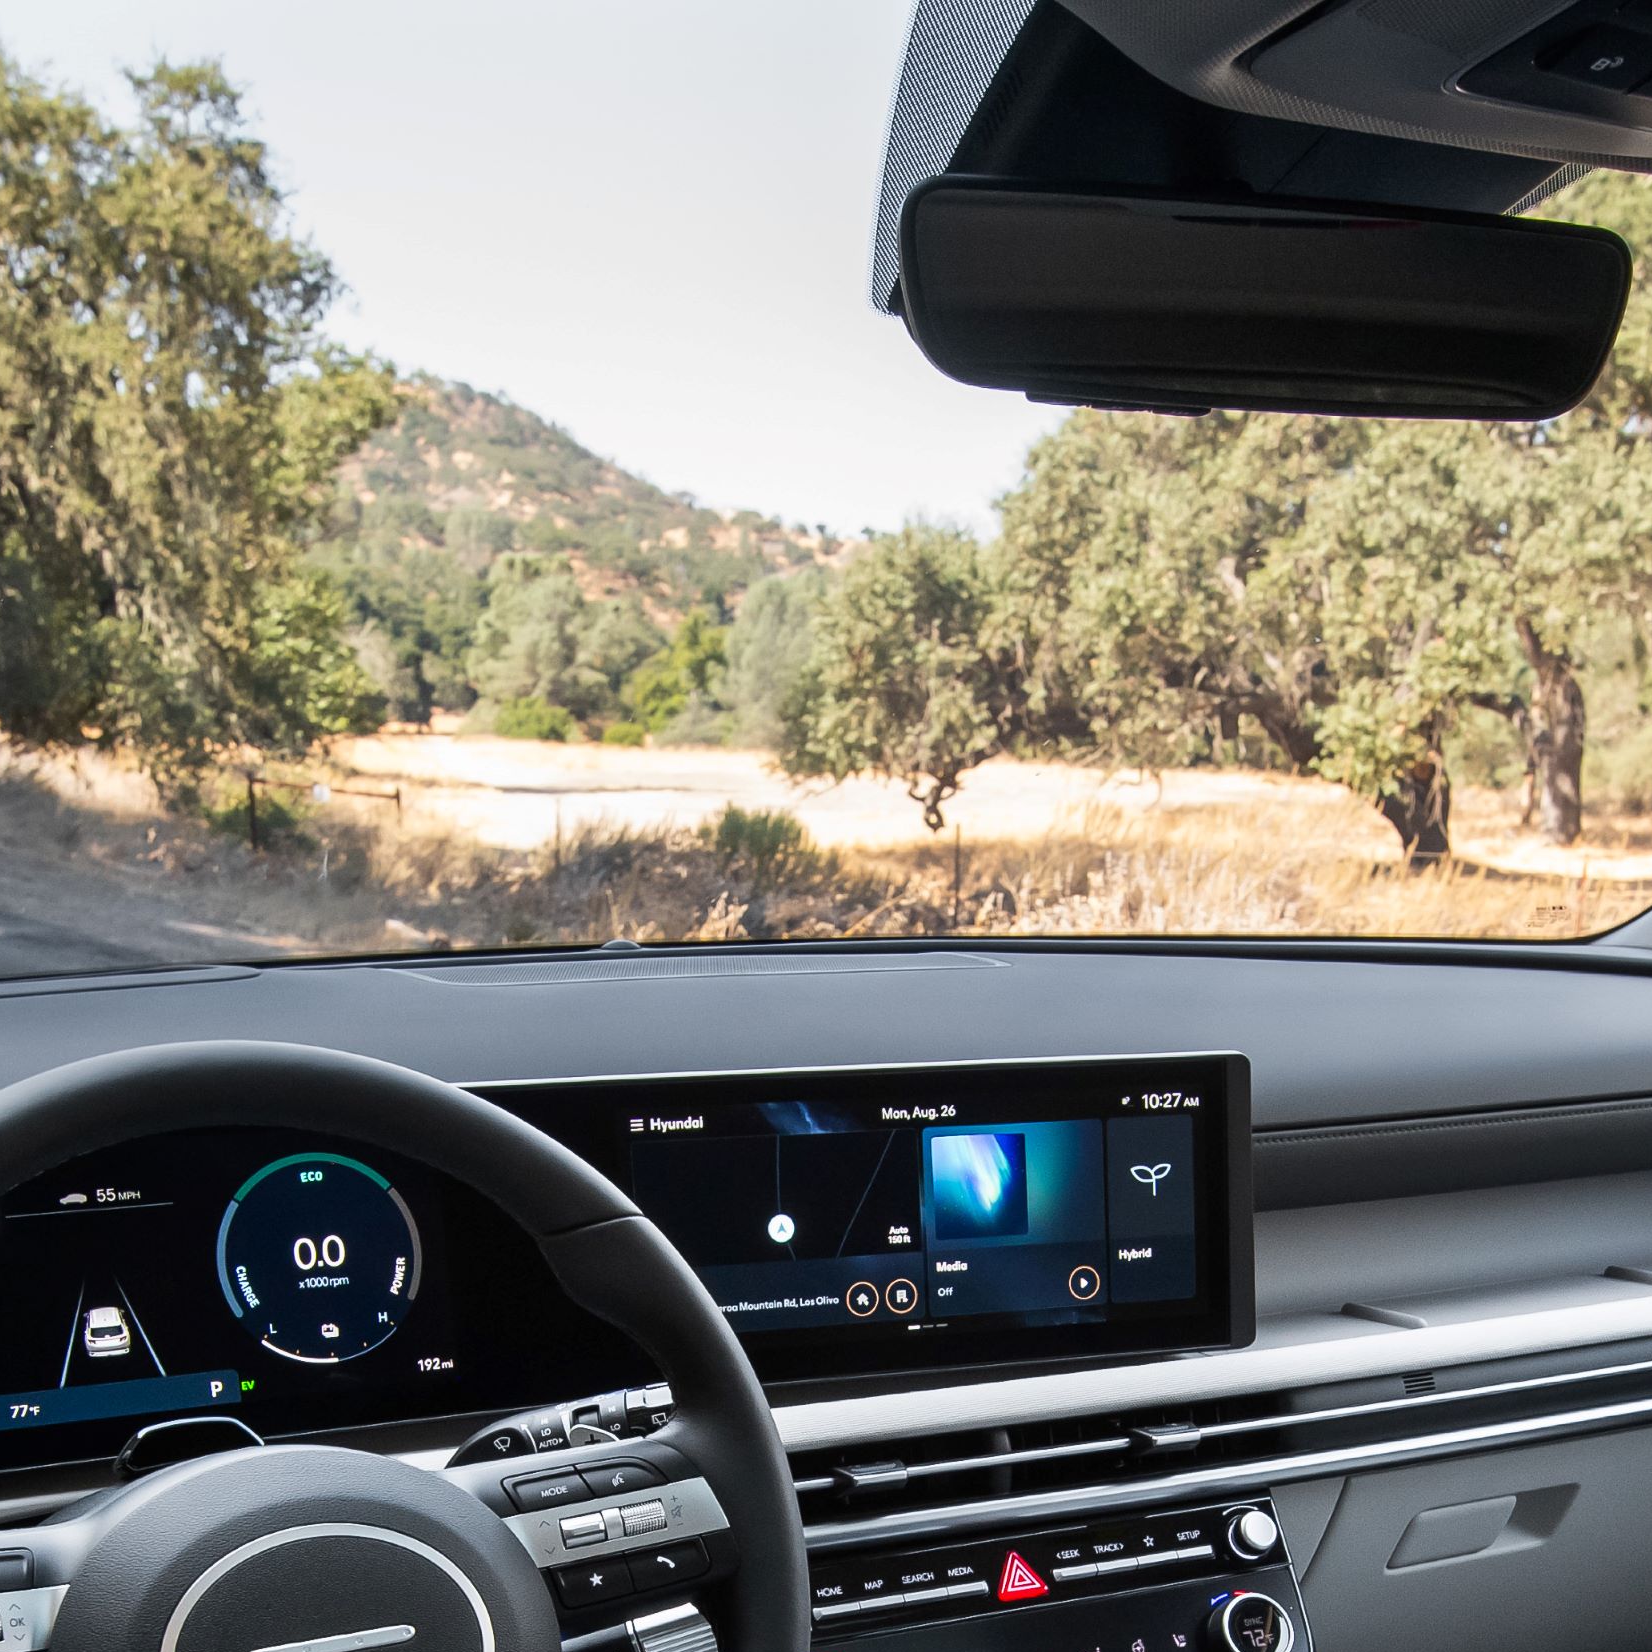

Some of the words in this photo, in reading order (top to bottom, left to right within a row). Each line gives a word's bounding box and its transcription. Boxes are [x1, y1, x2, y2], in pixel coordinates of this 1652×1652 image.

[1141, 1092, 1182, 1110] 10:27
[1183, 1096, 1200, 1107] AM
[881, 1107, 910, 1121] Mon,
[912, 1106, 939, 1121] Aug.
[940, 1104, 957, 1118] 26
[650, 1116, 704, 1134] Hyundai
[300, 1171, 323, 1183] ECO
[96, 1187, 116, 1202] 55
[118, 1190, 141, 1201] MPH
[889, 1225, 910, 1235] Auto
[887, 1235, 903, 1245] 150
[293, 1234, 346, 1270] 0.0
[1118, 1247, 1152, 1261] Hybrid
[936, 1261, 968, 1273] Media
[389, 1256, 406, 1295] POWER
[235, 1265, 260, 1308] CHARGE
[937, 1287, 954, 1298] Off
[738, 1299, 783, 1311] Mountain
[784, 1298, 798, 1308] Rd,
[800, 1297, 815, 1307] Los
[816, 1296, 839, 1305] Olivo
[378, 1311, 388, 1323] H
[269, 1323, 278, 1334] L
[210, 1381, 223, 1398] P
[241, 1380, 255, 1391] EV
[541, 1428, 552, 1437] LO
[610, 1423, 621, 1432] LO
[538, 1437, 559, 1449] AUTO
[540, 1485, 568, 1498] MODE
[1176, 1530, 1201, 1541] SETUP
[947, 1566, 974, 1577] MEDIA
[901, 1572, 935, 1584] SEARCH
[864, 1579, 884, 1591] MAP
[816, 1586, 843, 1598] HOME
[9, 1617, 26, 1628] OK
